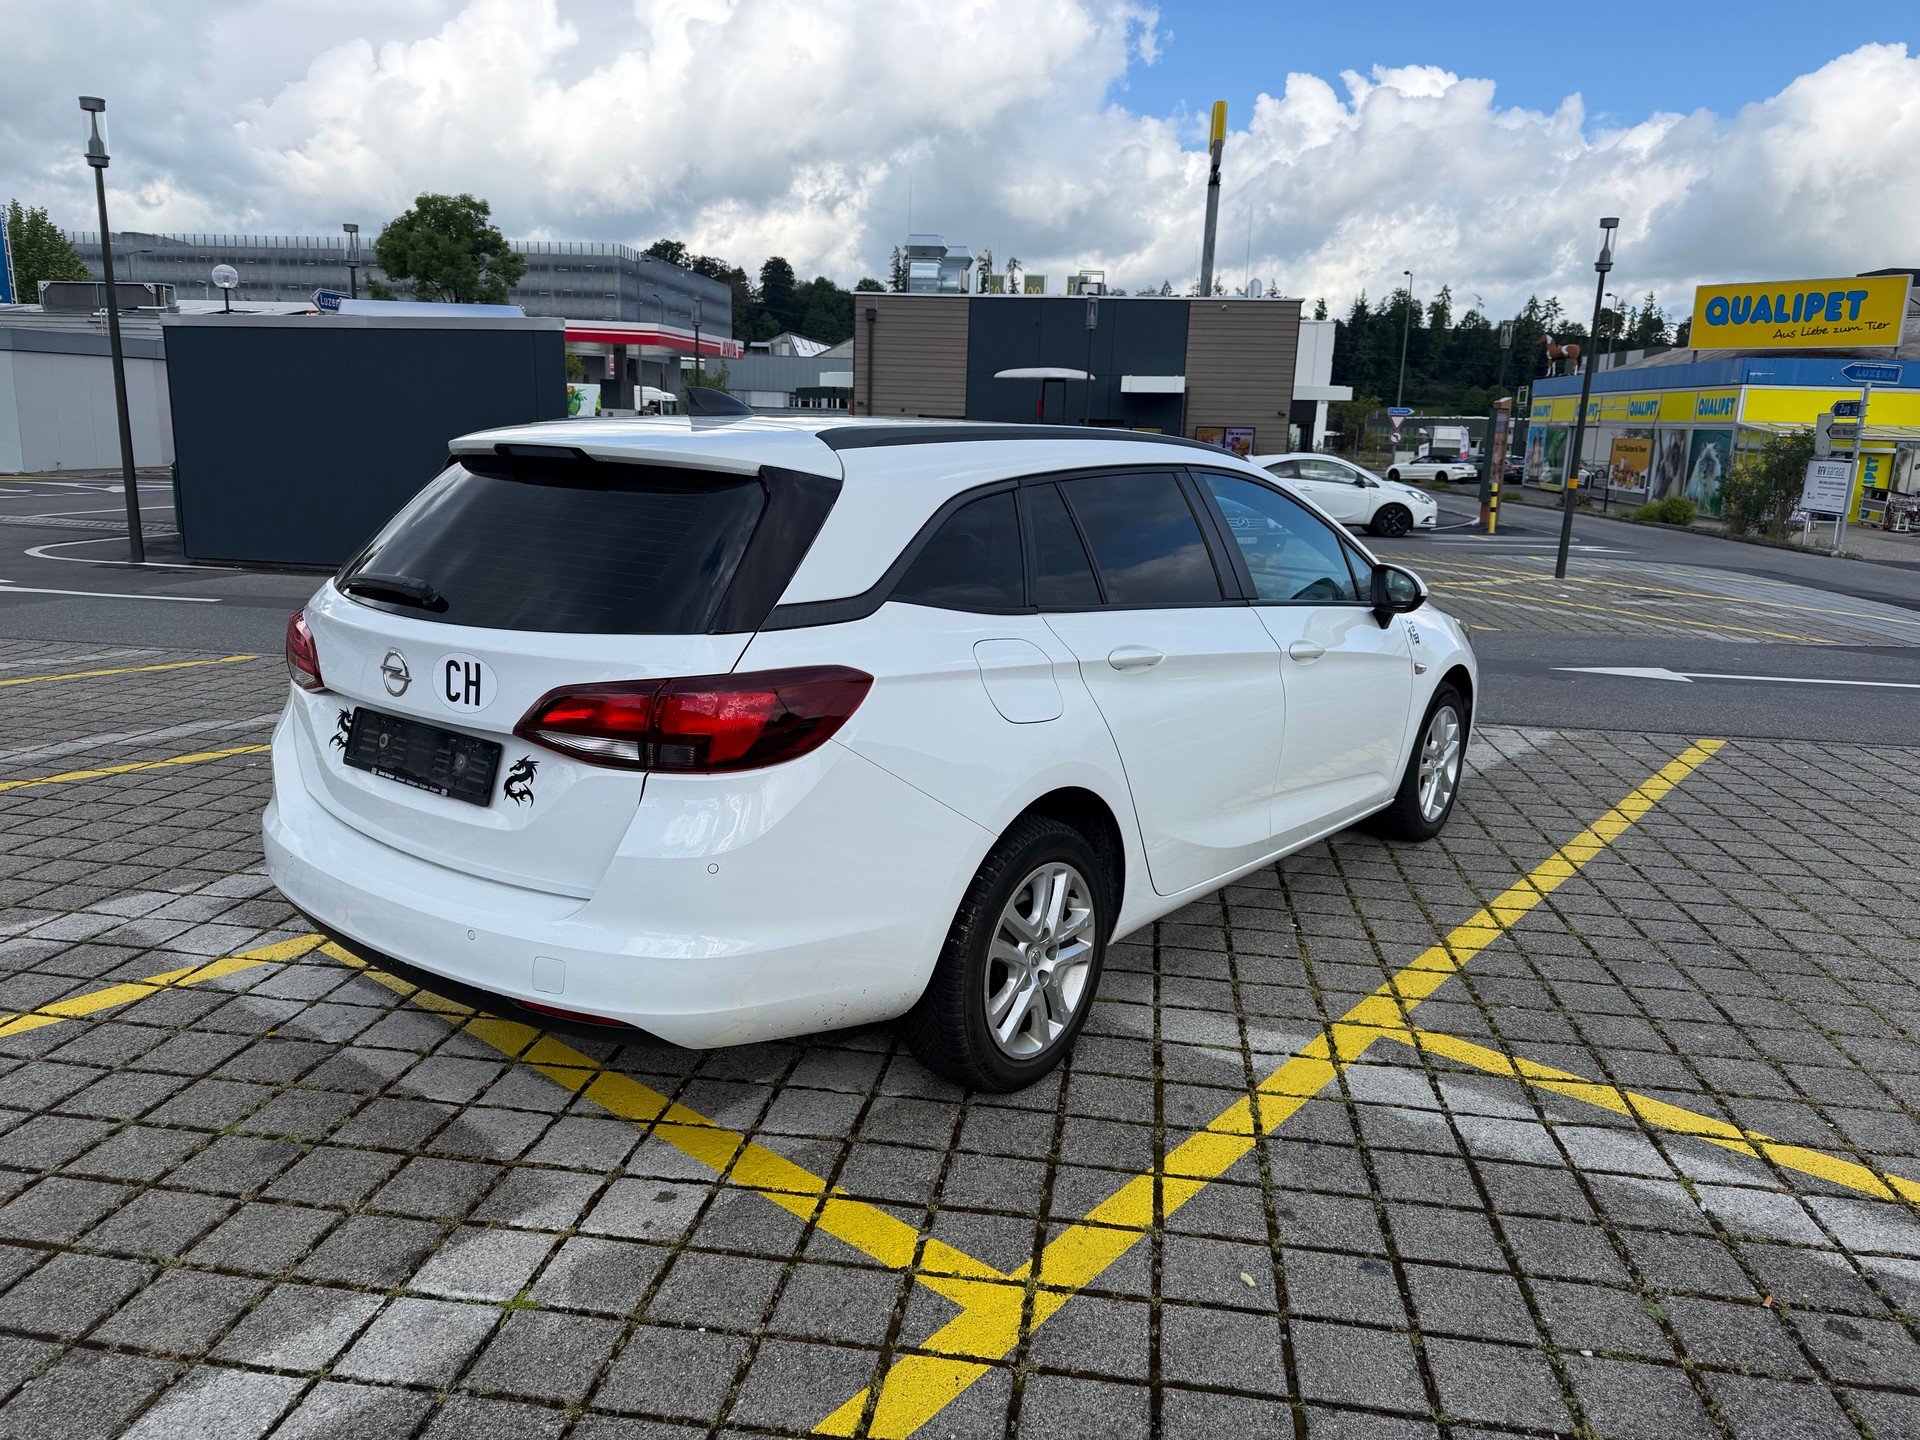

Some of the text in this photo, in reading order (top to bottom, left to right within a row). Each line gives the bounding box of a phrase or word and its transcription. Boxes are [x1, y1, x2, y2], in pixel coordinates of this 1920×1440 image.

[320, 293, 341, 308] Luzer
[1705, 290, 1869, 326] QUALIPET
[1772, 321, 1891, 340] Aus Liebe zum Tier
[722, 341, 737, 358] AVIA
[1855, 368, 1897, 379] LUZERN
[1630, 400, 1658, 417] QUALIPET
[1698, 397, 1736, 416] QUALIPET
[1840, 404, 1851, 416] Zug
[445, 659, 481, 706] CH
